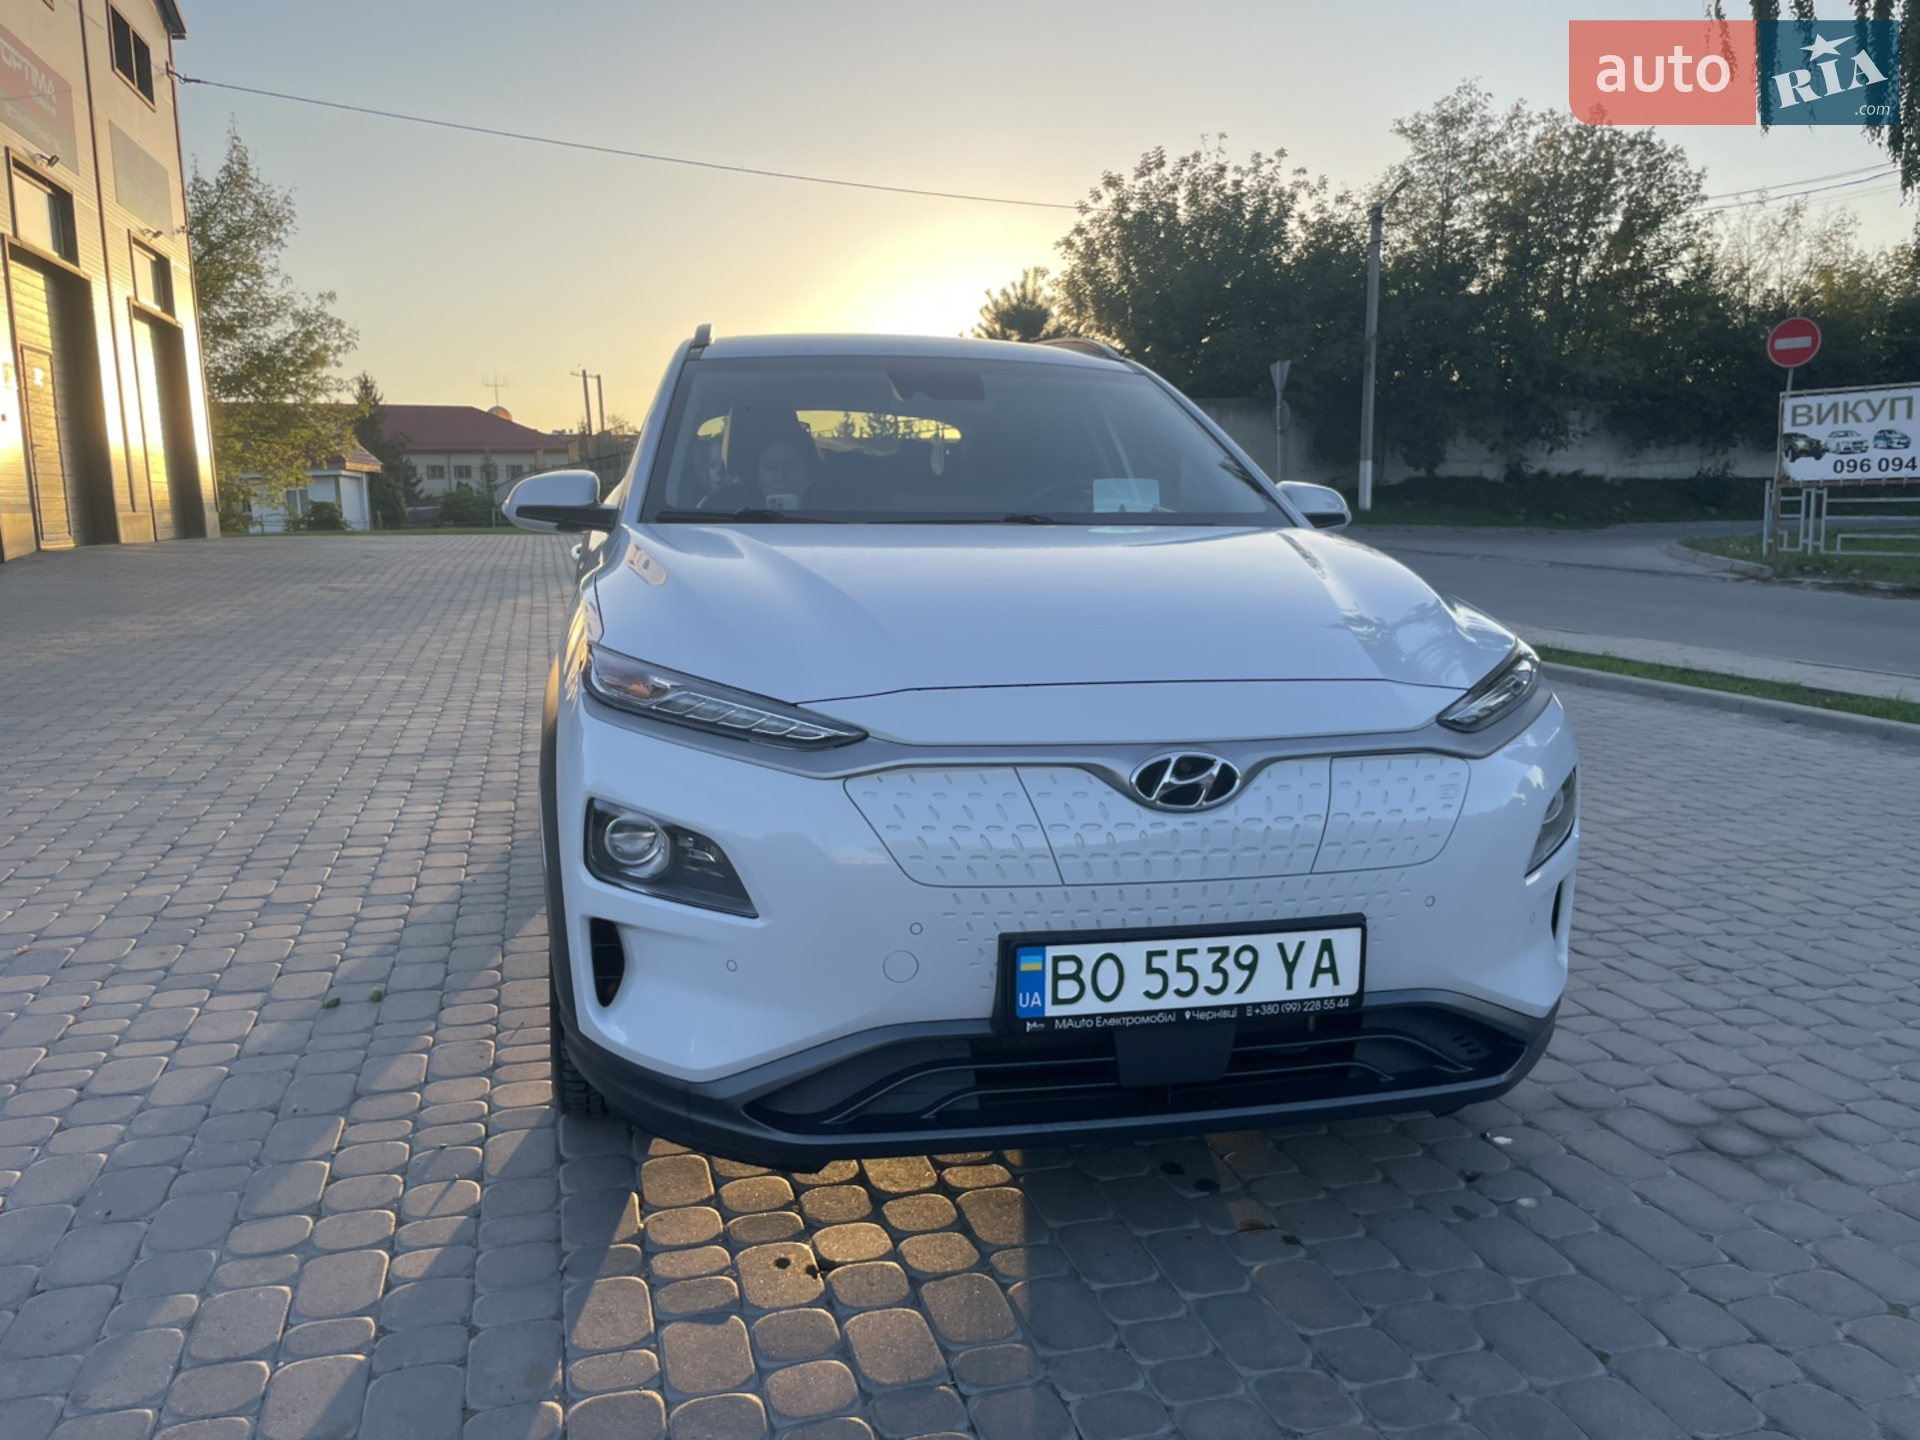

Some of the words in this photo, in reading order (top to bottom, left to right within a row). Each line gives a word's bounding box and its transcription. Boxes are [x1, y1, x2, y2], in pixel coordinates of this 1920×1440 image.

[1791, 396, 1914, 427] ВИКУП
[1833, 458, 1872, 474] 096
[1877, 456, 1918, 472] 094
[1051, 952, 1125, 1006] BO
[1143, 944, 1259, 1000] 5539
[1277, 938, 1340, 990] YA
[1019, 992, 1042, 1008] UA
[1055, 1018, 1094, 1030] MAuto
[1096, 1012, 1176, 1028] Електромобілі
[1192, 1007, 1238, 1021] Чернівці
[1255, 1003, 1279, 1015] +380
[1281, 1002, 1301, 1013] (99)
[1303, 1001, 1321, 1012] 228
[1323, 1000, 1335, 1010] 55
[1337, 998, 1349, 1008] 44
